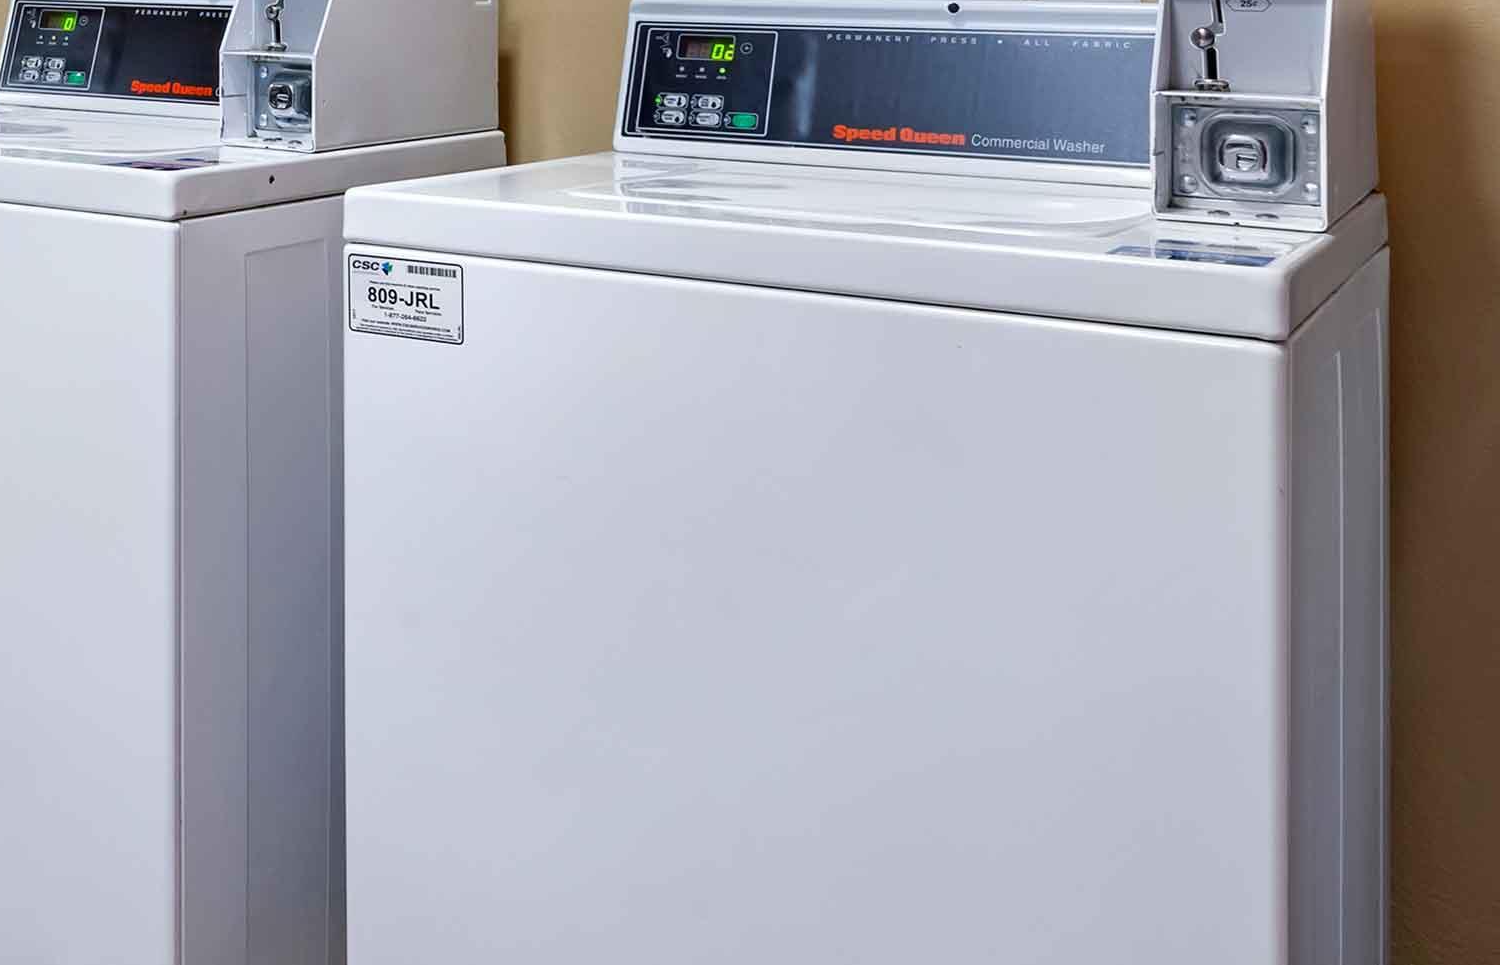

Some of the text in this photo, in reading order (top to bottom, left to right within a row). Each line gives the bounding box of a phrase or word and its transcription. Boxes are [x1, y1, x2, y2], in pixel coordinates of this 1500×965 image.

[826, 33, 1132, 49] PERMANENT PRESS ALL FABRIC
[130, 79, 171, 95] Speed
[171, 82, 213, 97] Queen
[832, 123, 1106, 154] Speed Queen Commercial Washer
[352, 259, 380, 271] CSC
[367, 286, 441, 310] 809-JRL
